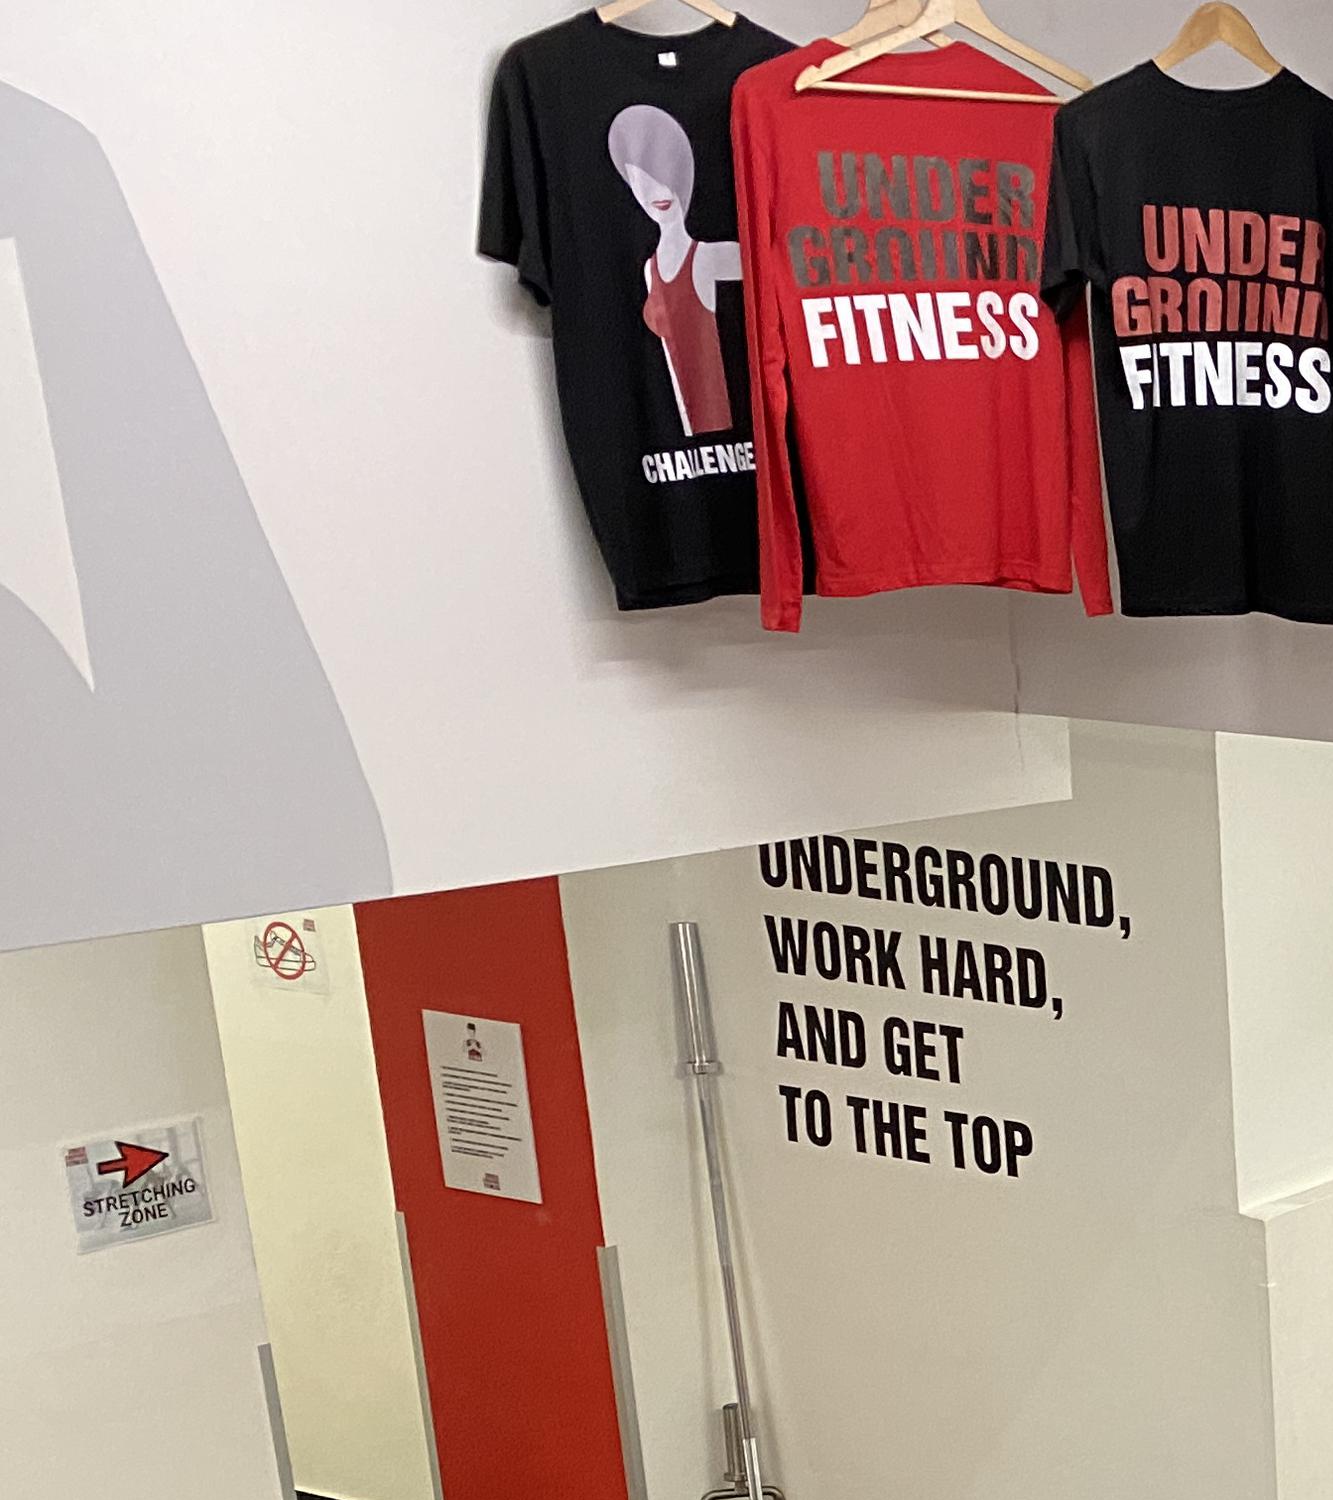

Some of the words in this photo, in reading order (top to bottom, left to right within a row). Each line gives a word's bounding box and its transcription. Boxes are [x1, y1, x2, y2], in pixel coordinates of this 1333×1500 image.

[817, 150, 1035, 229] UNDER
[787, 225, 1039, 288] GROUND
[801, 291, 1039, 368] FITNESS
[1119, 341, 1331, 414] FITNESS
[758, 834, 1131, 940] UNDERGROUND,
[763, 914, 906, 991] WORK
[919, 934, 1063, 1020] HARD,
[776, 1001, 866, 1069] AND
[883, 1016, 964, 1084] GET
[778, 1085, 832, 1148] TO
[846, 1095, 931, 1164] THE
[944, 1110, 1034, 1178] TOP
[83, 1178, 197, 1218] STRETCHING
[119, 1203, 169, 1228] ZONE
